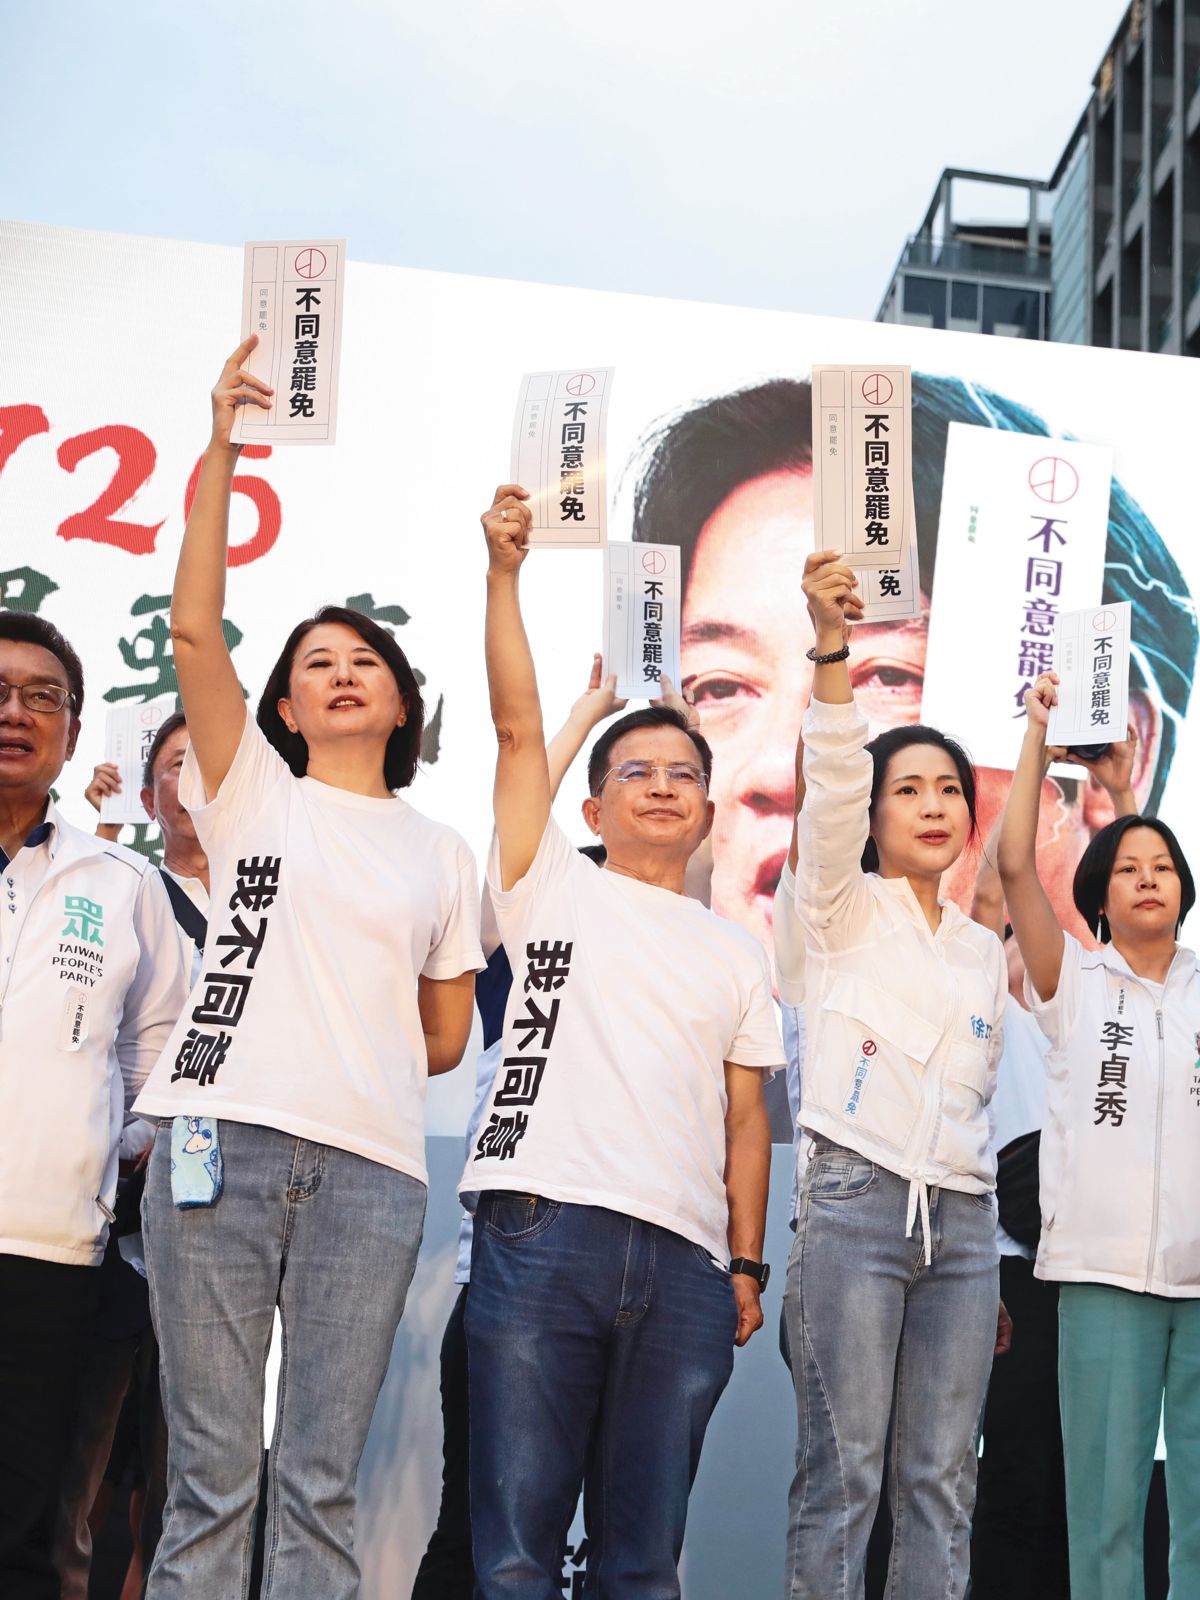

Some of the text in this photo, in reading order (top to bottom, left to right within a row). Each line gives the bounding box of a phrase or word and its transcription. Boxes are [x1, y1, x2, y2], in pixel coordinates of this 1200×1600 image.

[288, 287, 321, 418] 不同意罷免
[559, 401, 588, 522] 不同意罷免
[864, 414, 890, 546] 不同意罷免
[642, 580, 664, 683] 不同意罷免
[1090, 636, 1113, 726] 不同意罷免
[52, 956, 104, 978] PEOPLE'S
[58, 943, 104, 964] TAIWAN
[60, 970, 96, 988] PARTY
[171, 855, 282, 1087] 我不同意
[473, 940, 574, 1161] 我不同意
[845, 1056, 870, 1115] 不同意罷免
[1093, 1021, 1134, 1127] 李貞秀
